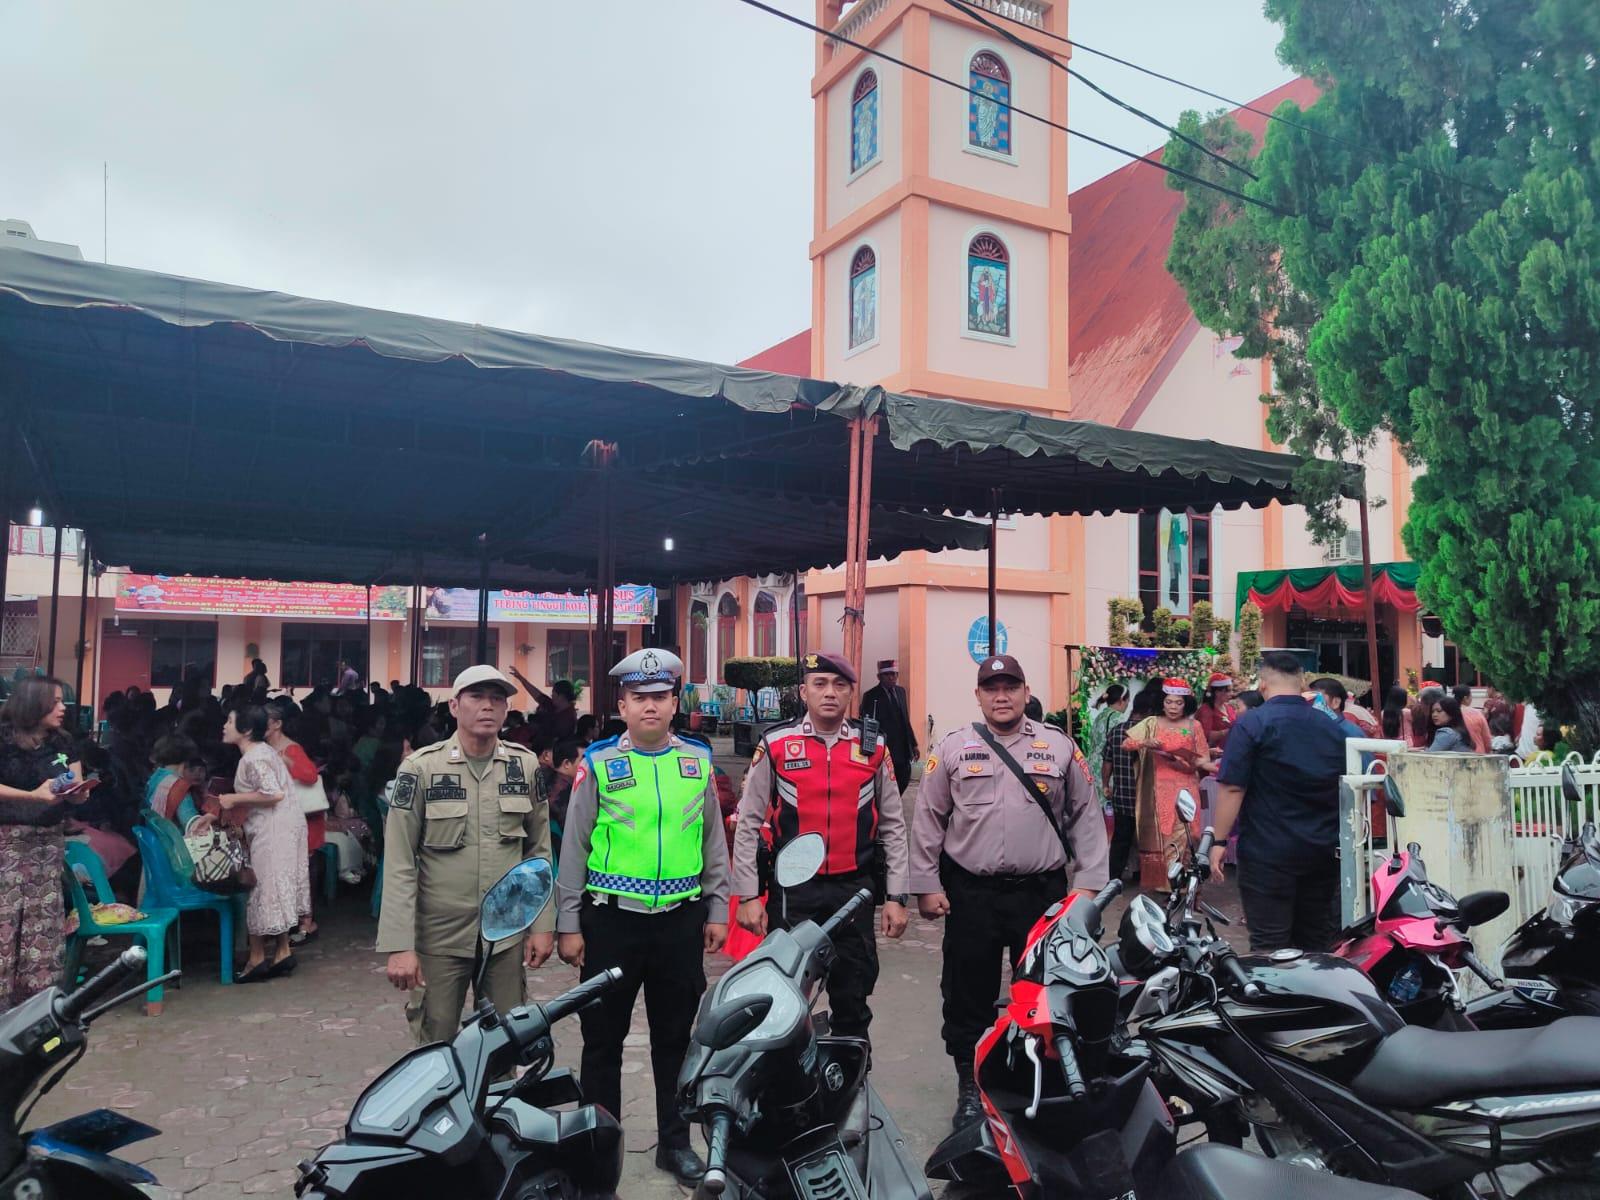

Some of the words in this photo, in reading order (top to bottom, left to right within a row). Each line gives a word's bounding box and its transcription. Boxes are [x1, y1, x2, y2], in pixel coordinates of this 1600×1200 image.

[206, 577, 245, 586] JEMAAT
[495, 600, 528, 609] TEBING
[531, 601, 562, 610] TINGGI
[566, 602, 589, 611] KOTA
[1026, 751, 1056, 762] POLRI
[501, 784, 517, 794] POL
[1517, 980, 1545, 988] HONDA
